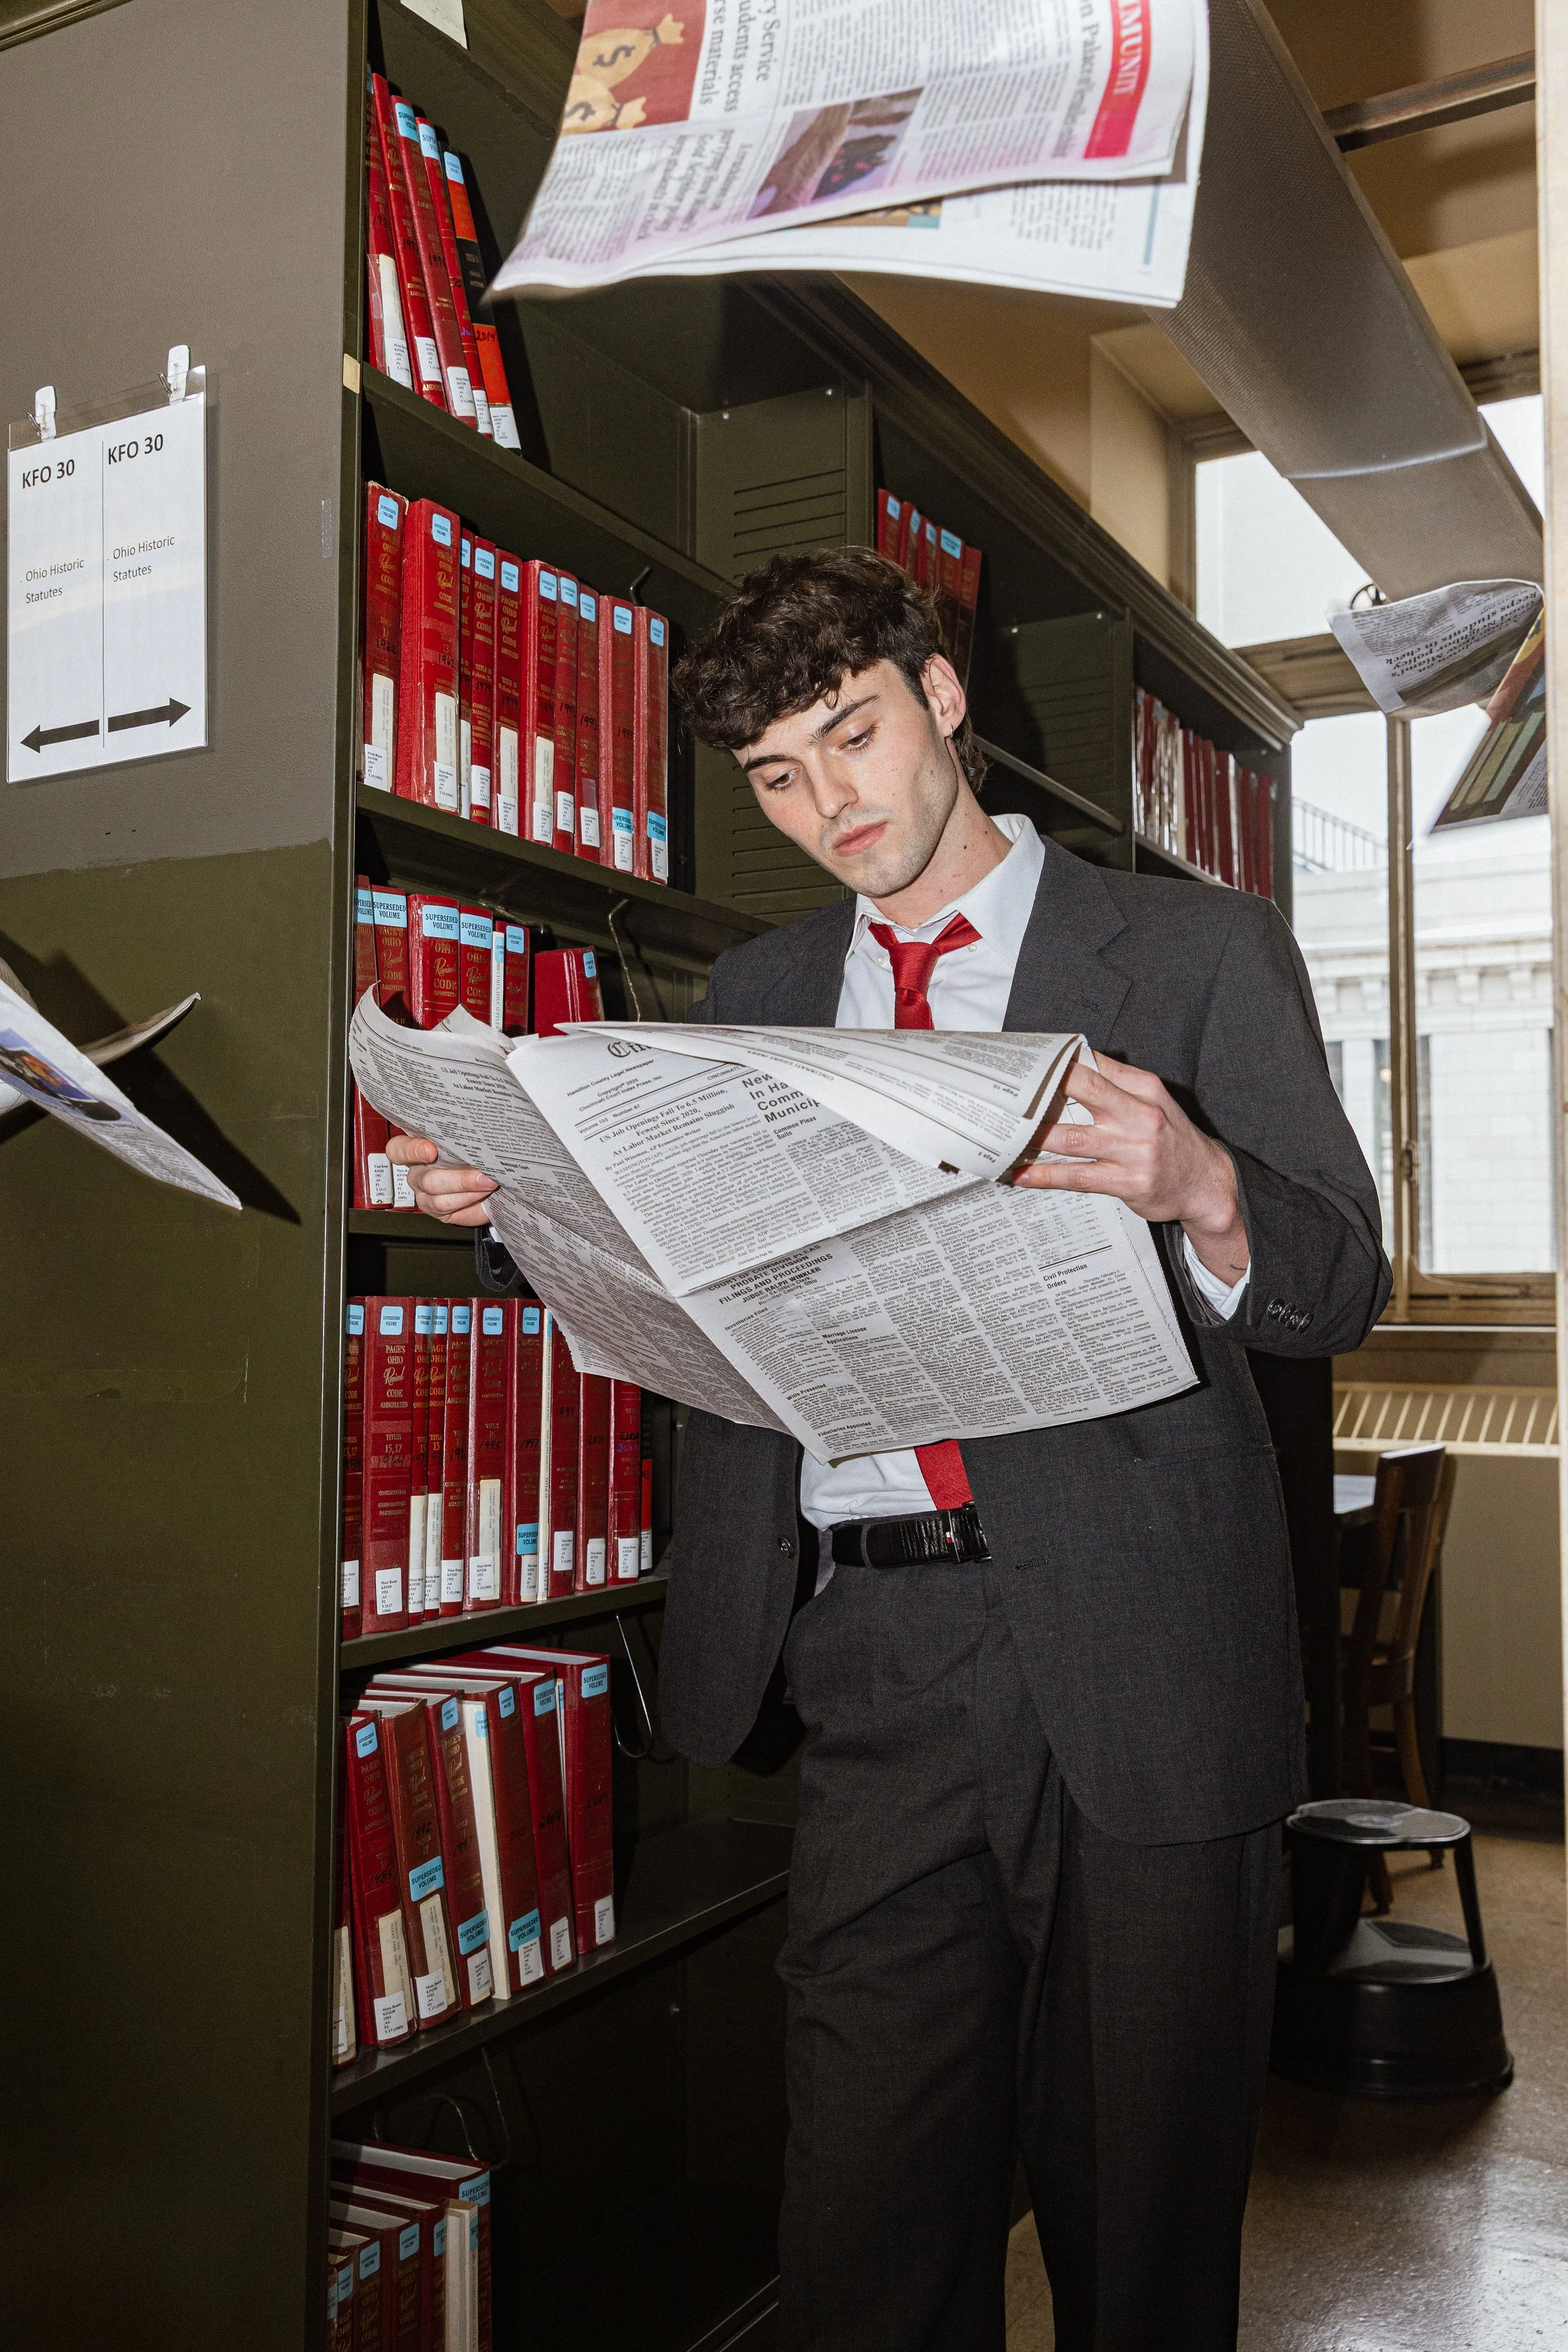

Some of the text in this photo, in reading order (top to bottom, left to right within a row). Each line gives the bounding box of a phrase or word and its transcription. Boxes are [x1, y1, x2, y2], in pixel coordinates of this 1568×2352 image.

[756, 19, 780, 82] Service
[699, 31, 724, 104] materials
[726, 64, 744, 112] access
[476, 330, 496, 342] 2014
[109, 434, 163, 464] KFO 30
[23, 459, 75, 489] KFO 30
[434, 522, 448, 533] SUPERSEDED
[114, 536, 174, 559] Ohio Historic
[26, 559, 84, 581] Ohio Historic
[114, 565, 151, 581] Statutes
[439, 562, 452, 572] OHIO
[26, 588, 62, 603] Statutes
[439, 592, 452, 603] CODE
[1501, 592, 1536, 612] keeps
[502, 607, 516, 618] OHIO
[1441, 610, 1496, 644] students
[503, 635, 516, 647] CODE
[439, 654, 455, 668] 1962
[1385, 647, 1420, 664] check
[1394, 650, 1434, 669] policy
[1391, 653, 1443, 677] Miami's
[373, 902, 406, 911] SUPERSEDED
[379, 911, 400, 919] VOLUME
[425, 914, 458, 923] SUPERSEDED
[433, 922, 453, 930] VOLUME
[462, 922, 491, 933] SUPERSEDED
[382, 938, 401, 946] OHIO
[468, 930, 486, 940] VOLUME
[381, 949, 403, 968] Revised
[434, 958, 456, 977] Revised
[383, 972, 403, 980] CODE
[434, 980, 457, 990] CODE
[770, 1056, 793, 1066] COURT
[567, 1059, 654, 1096] Hamilton County Legal Newspaper
[795, 1063, 834, 1081] CINCINNATI
[742, 1073, 773, 1088] New
[580, 1098, 605, 1111] Cincinnati
[606, 1091, 620, 1099] Court
[750, 1089, 765, 1099] In
[758, 1090, 803, 1111] Comm
[579, 1123, 598, 1133] Volume
[613, 1108, 633, 1118] Number
[613, 1129, 625, 1137] Job
[626, 1116, 659, 1130] Openings
[660, 1108, 674, 1117] Fall
[698, 1089, 728, 1104] Million,
[623, 1140, 644, 1152] Labor
[645, 1129, 672, 1142] Market
[673, 1116, 703, 1131] Remains
[704, 1103, 734, 1121] Sluggish
[636, 1108, 701, 1136] Fewest Since 2020,
[773, 1116, 817, 1135] Common Pleas
[776, 1131, 793, 1140] Suits
[625, 1151, 649, 1161] Wiseman,
[658, 1136, 684, 1148] Economics
[708, 1276, 736, 1291] COURT
[753, 1257, 792, 1273] COMMON
[793, 1245, 820, 1258] PLEAS
[730, 1256, 809, 1290] PROBATE DIVISION
[1057, 1264, 1087, 1276] Protection
[719, 1254, 833, 1304] FILINGS AND PROCEEDINGS
[743, 1267, 821, 1303] JUDGE RALPH WINKLER
[1047, 1280, 1066, 1289] Orders
[758, 1293, 783, 1305] Hamilton
[783, 1285, 803, 1294] County,
[770, 1283, 795, 1295] Ex-Officio
[724, 1307, 768, 1330] Inventories Filed
[822, 1330, 845, 1339] Marriage
[827, 1335, 859, 1344] Applications
[386, 1345, 405, 1353] PAGE'S
[388, 1356, 403, 1364] OHIO
[384, 1367, 405, 1385] Revised
[387, 1389, 403, 1397] CODE
[787, 1384, 827, 1401] Wills Presented
[818, 1422, 871, 1437] Fiduciaries Appointed
[384, 1444, 402, 1453] 15,17
[377, 1454, 405, 1468] 1964
[583, 1671, 607, 1683] SUPERSEDED
[589, 1679, 603, 1689] VOLUME
[536, 1687, 554, 1700] SUPERSEDED
[539, 1696, 552, 1706] VOLUME
[359, 1732, 374, 1743] SUPERSEDED
[363, 1739, 373, 1747] VOLUME
[411, 1864, 442, 1884] SUPERSEDED
[418, 1874, 437, 1888] VOLUME
[460, 1918, 487, 1938] SUPERSEDED
[511, 1917, 539, 1936] SUPERSEDED
[517, 1927, 536, 1941] VOLUME
[467, 1928, 484, 1942] VOLUME
